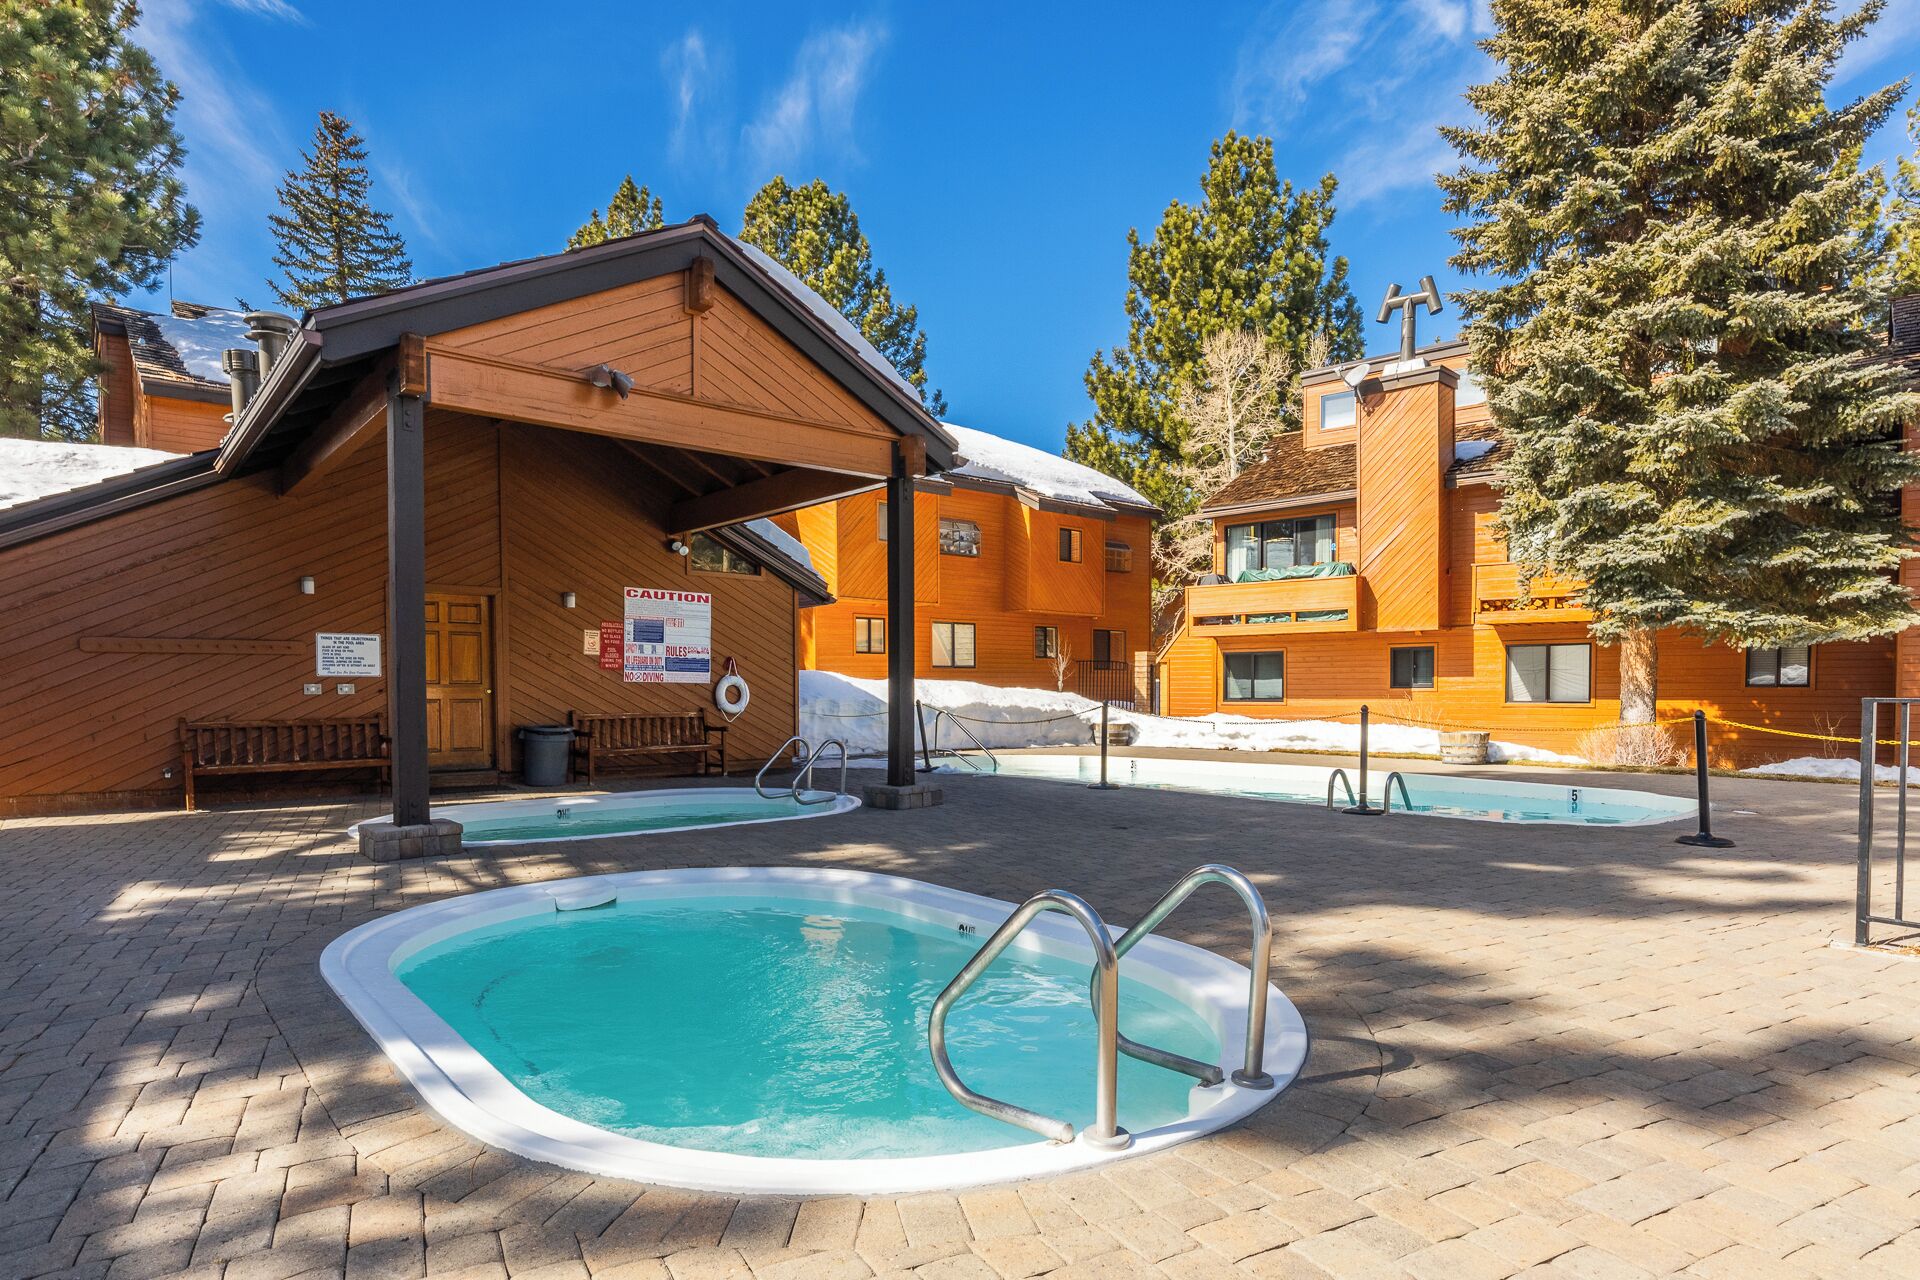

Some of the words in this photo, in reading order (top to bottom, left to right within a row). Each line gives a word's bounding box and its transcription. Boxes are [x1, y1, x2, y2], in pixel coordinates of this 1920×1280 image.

[626, 589, 710, 603] CAUTION
[665, 645, 688, 657] RULES
[625, 671, 634, 681] NO
[643, 672, 664, 682] DIVING
[1571, 789, 1578, 801] 5
